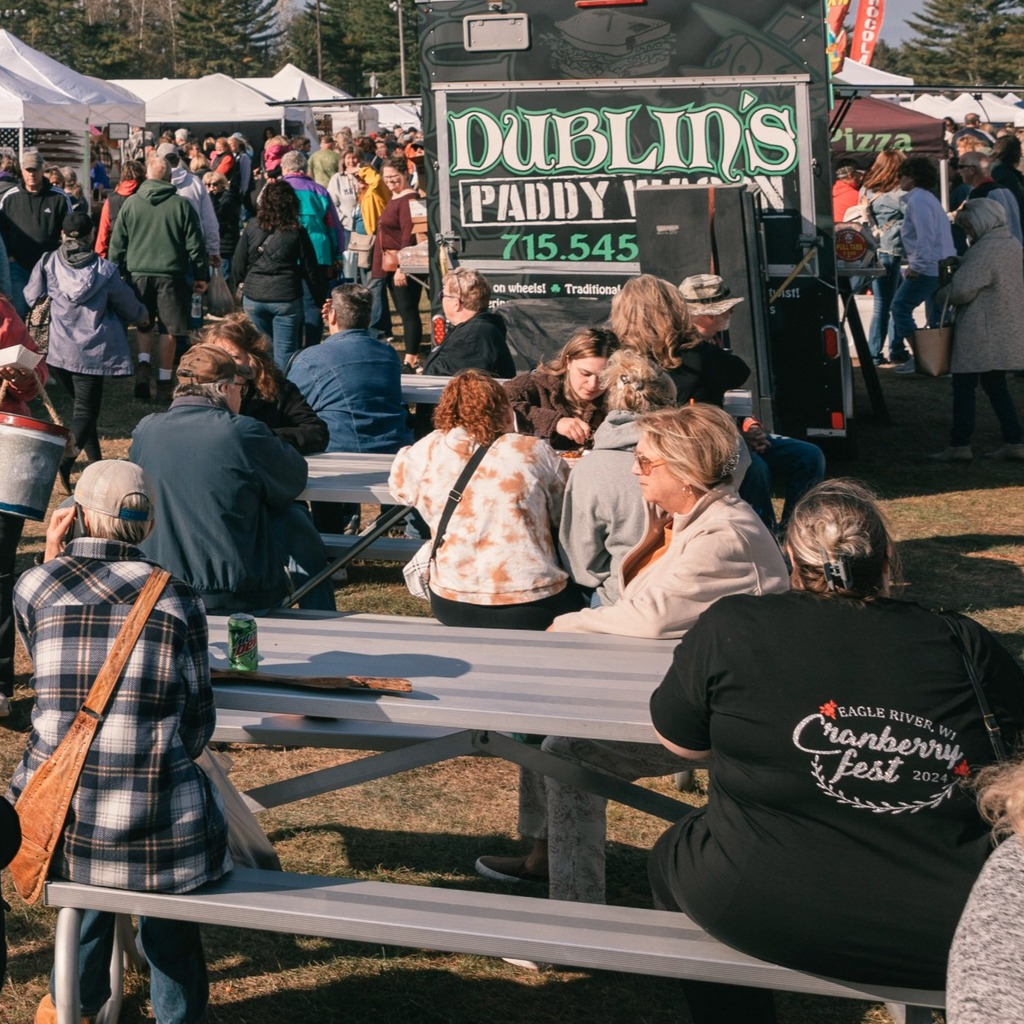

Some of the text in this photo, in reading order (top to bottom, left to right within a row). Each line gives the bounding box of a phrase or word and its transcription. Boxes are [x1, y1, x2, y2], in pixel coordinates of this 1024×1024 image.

[470, 180, 609, 222] PADDY
[493, 284, 506, 293] on
[508, 283, 546, 294] wheels!
[837, 706, 958, 741] EAGLE RIVER, WI
[792, 713, 964, 770] Cranberry
[912, 770, 948, 783] 2024
